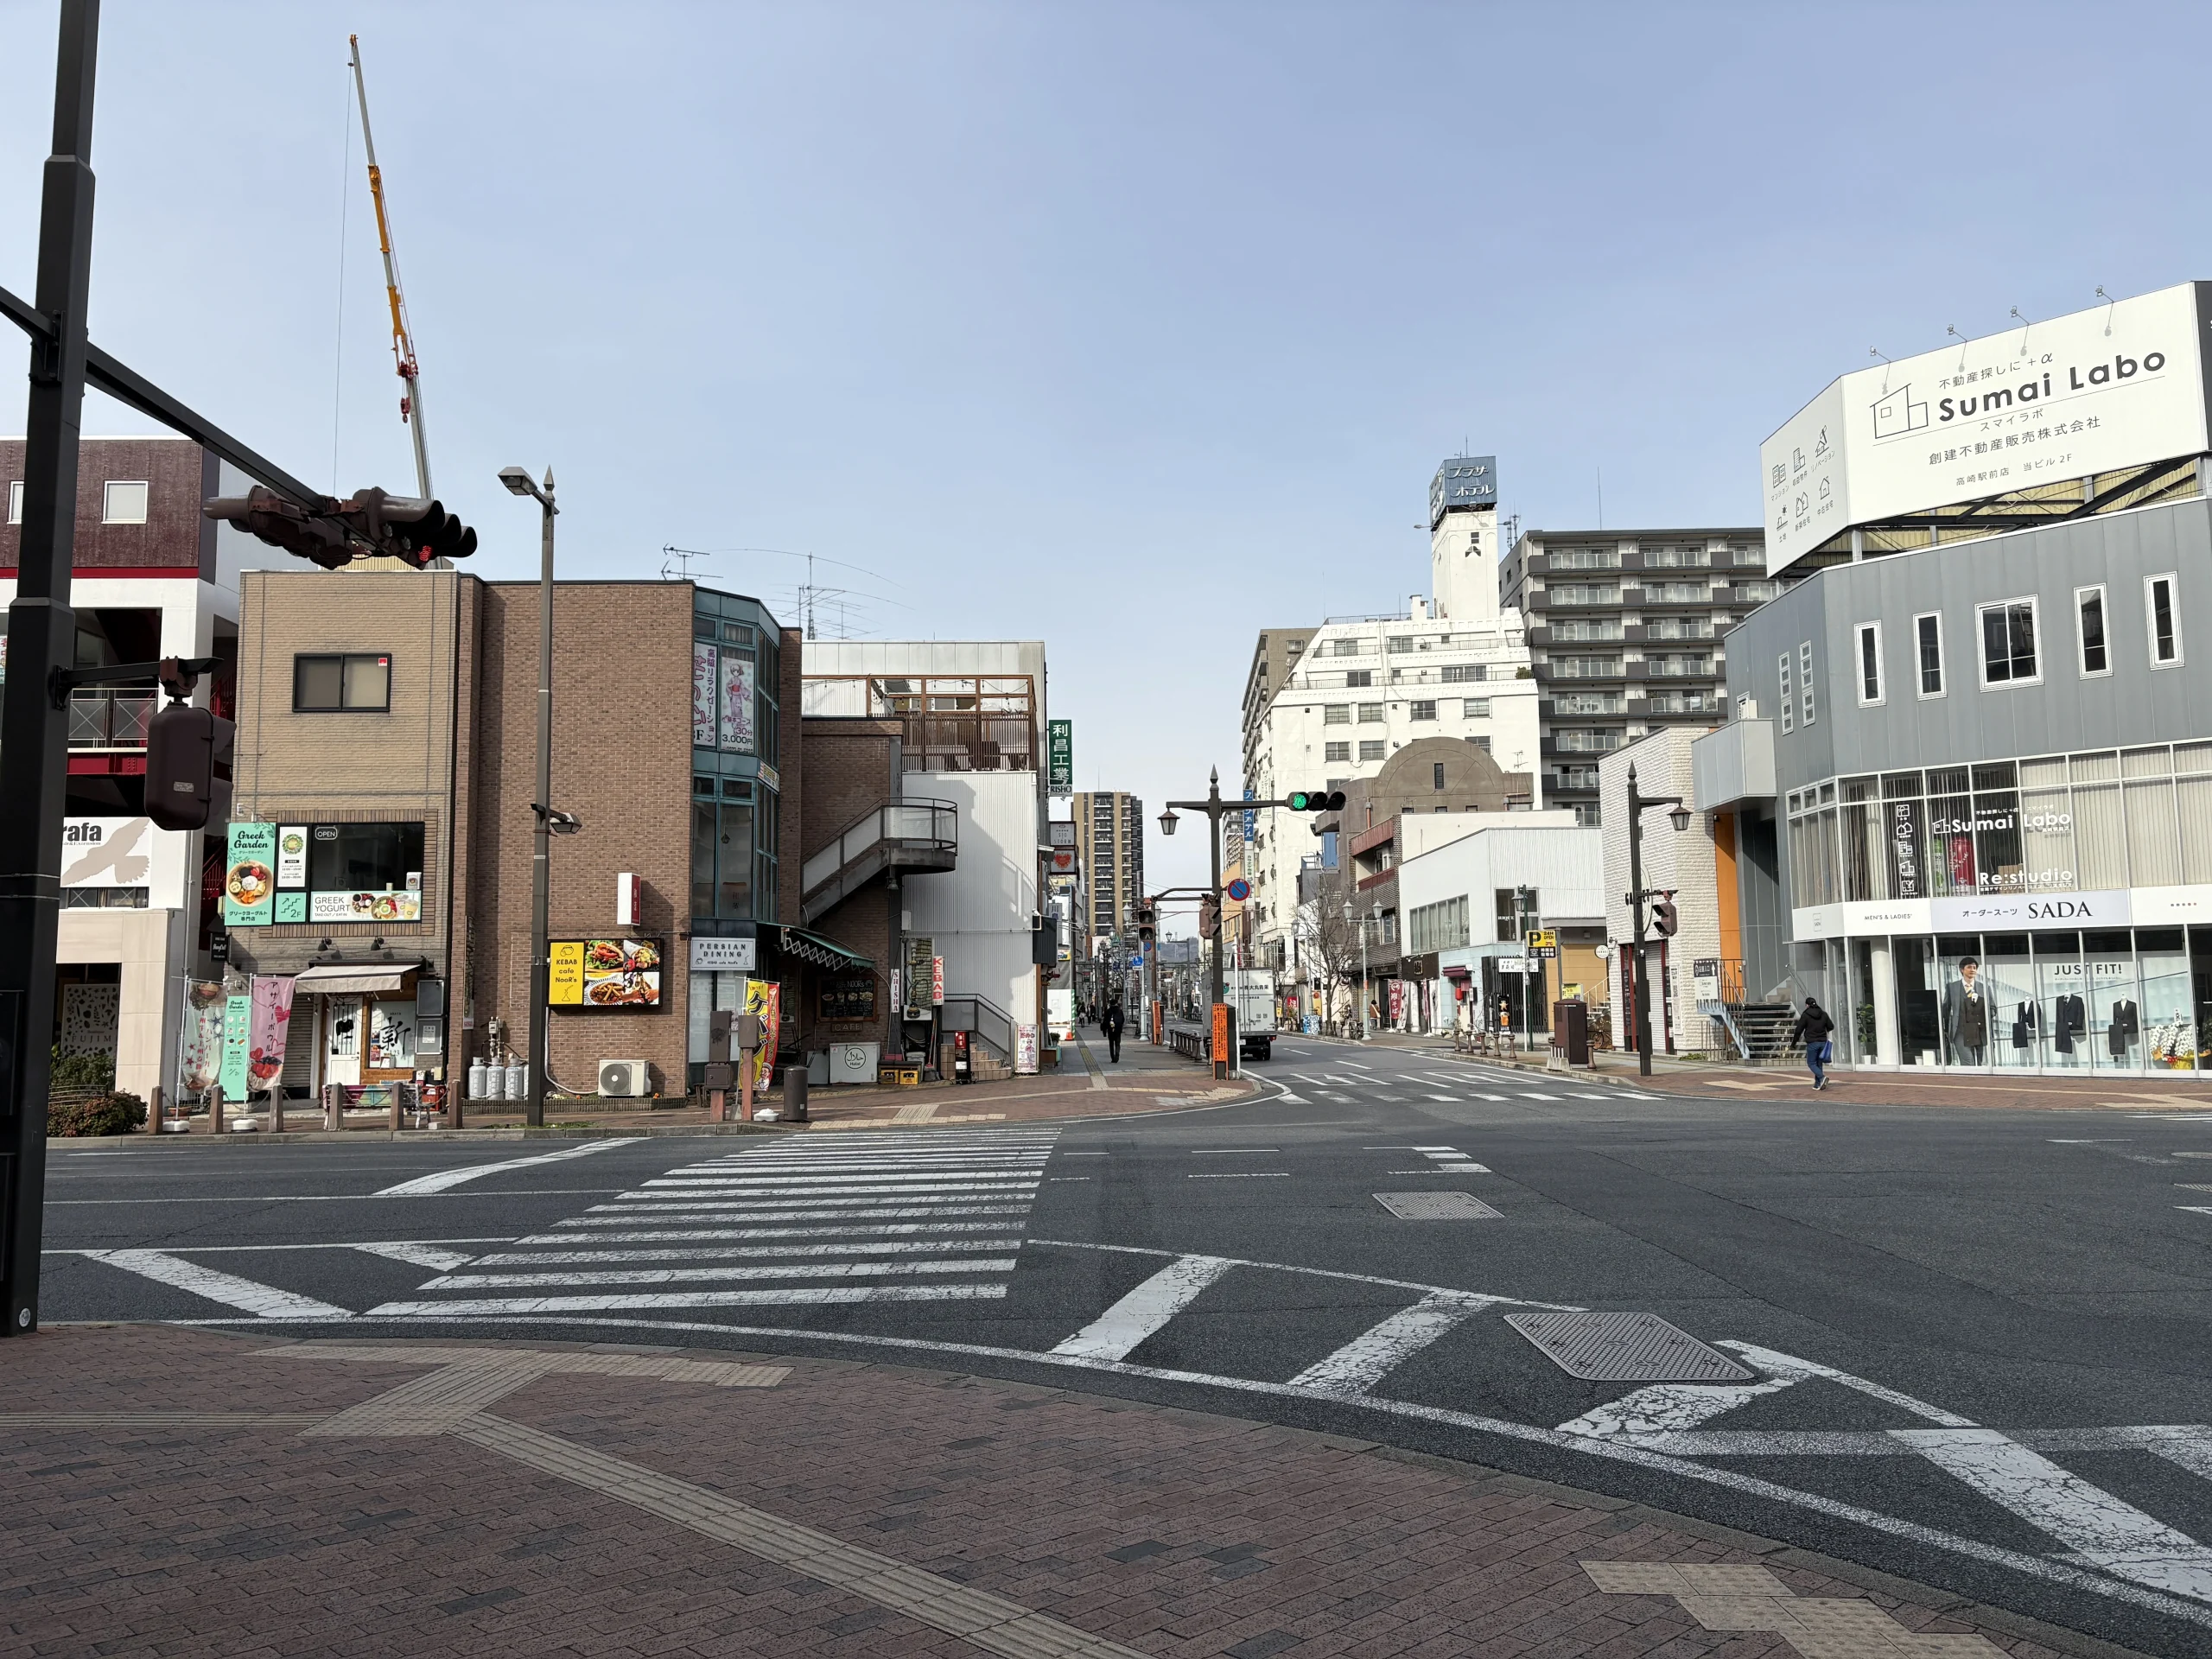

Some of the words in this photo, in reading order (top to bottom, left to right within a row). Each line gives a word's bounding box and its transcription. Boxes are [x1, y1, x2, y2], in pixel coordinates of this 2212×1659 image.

[1939, 372, 2051, 422] Sumai
[2069, 352, 2165, 391] Labo
[1980, 408, 2044, 432] スマイラボ
[1929, 416, 2101, 466] 創建不動産販売株式会社
[1446, 466, 1489, 479] プラザ
[1956, 467, 2010, 486] 高崎駅前店
[1450, 484, 1495, 498] ホテル
[1771, 485, 1789, 501] マンション
[1052, 723, 1070, 780] 利昌工業
[1050, 785, 1071, 793] RISHO
[1952, 815, 2013, 833] Sumai
[2024, 812, 2071, 828] Labo
[238, 830, 265, 840] Greek
[233, 840, 269, 849] Garden
[1980, 868, 2073, 886] Re:studio
[290, 909, 302, 918] 2F
[1962, 907, 2018, 918] オーダースーツ
[2028, 901, 2094, 919] SADA
[1529, 931, 1541, 946] P
[2054, 964, 2089, 976] JUST
[2096, 963, 2122, 975] FIT!
[932, 957, 943, 1000] KEBAB
[265, 982, 278, 1052] アサイーボウル
[378, 1016, 411, 1055] 新
[835, 1023, 861, 1032] CAFE
[847, 1052, 863, 1061] حلال
